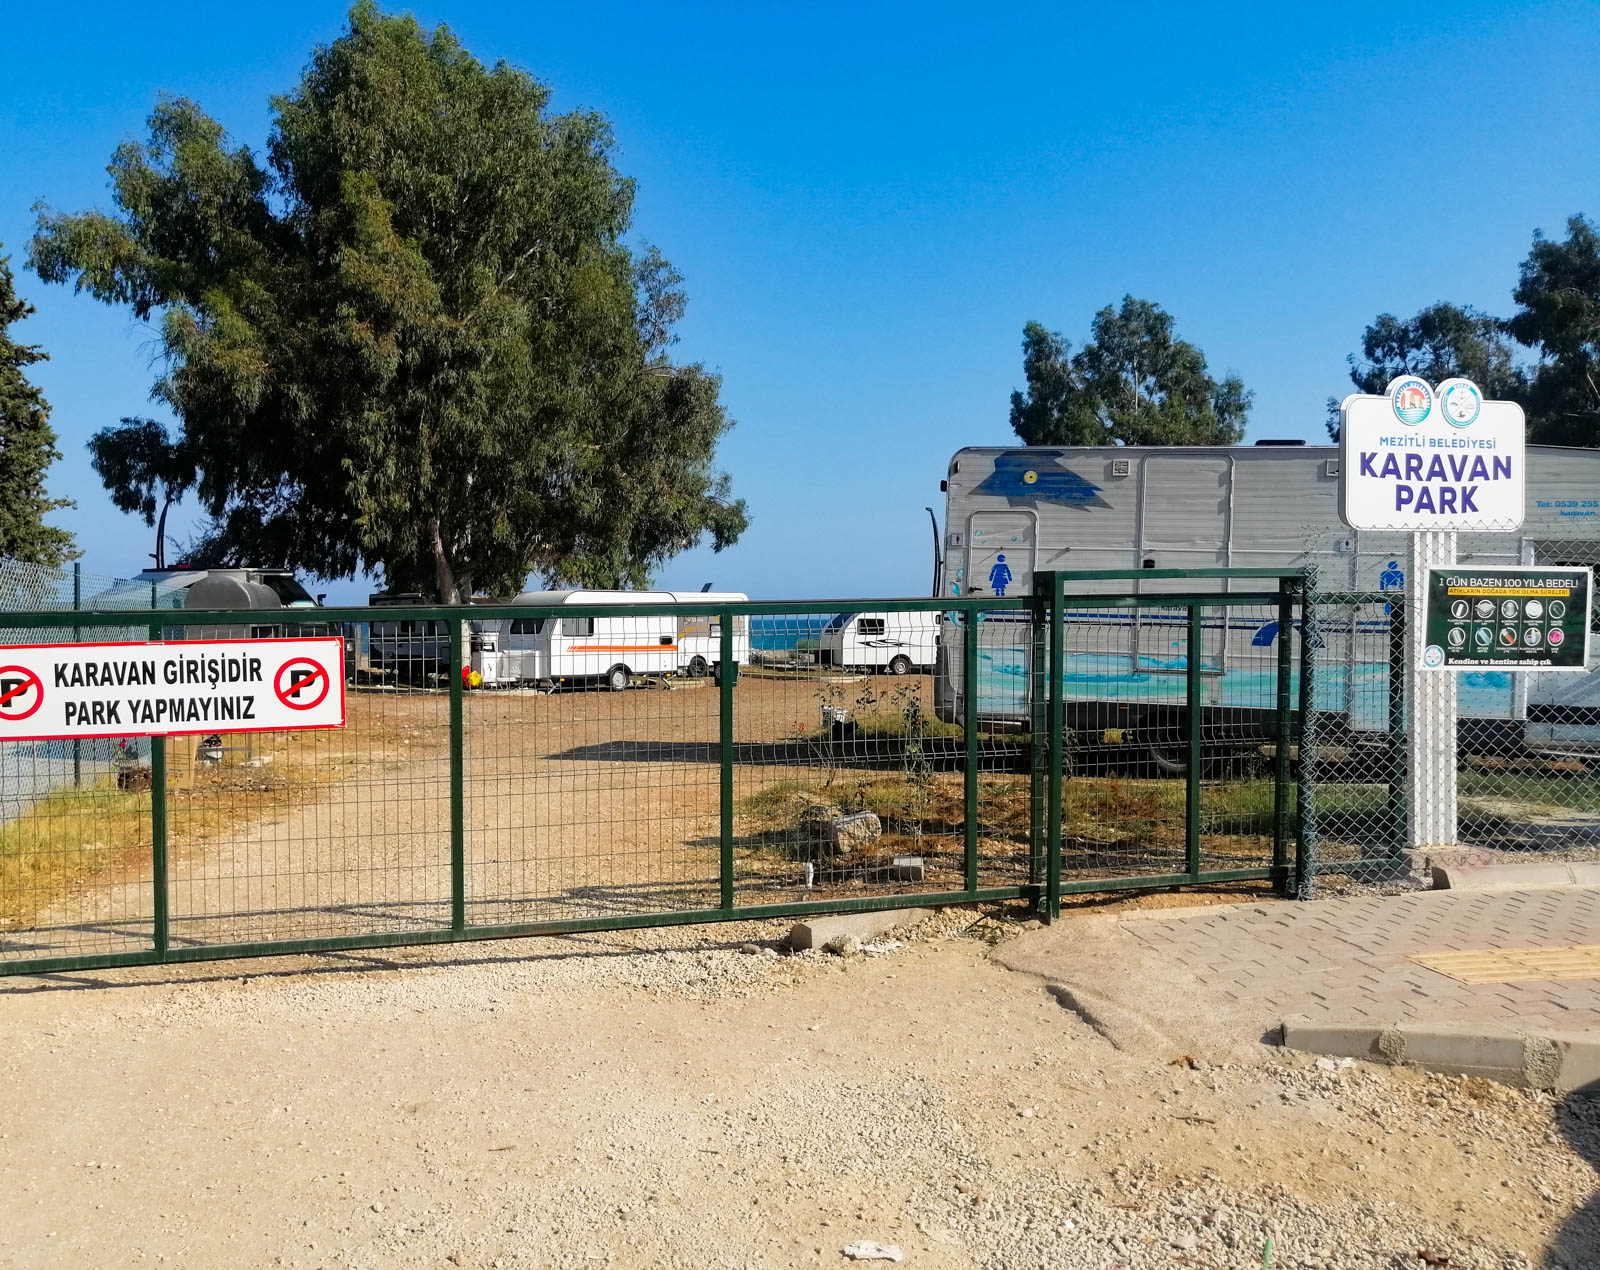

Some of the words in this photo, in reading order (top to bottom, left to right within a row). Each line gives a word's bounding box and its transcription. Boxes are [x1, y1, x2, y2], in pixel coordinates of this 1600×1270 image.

[1379, 434, 1426, 448] MEZİTLİ
[1429, 435, 1497, 449] BELEDİYESİ
[1360, 451, 1512, 482] KARAVAN
[1395, 484, 1479, 515] PARK
[1439, 577, 1444, 587] 1
[1446, 575, 1468, 587] GÜN
[1469, 577, 1502, 588] BAZEN
[1503, 578, 1522, 588] 100
[1523, 578, 1545, 588] YILA
[1546, 579, 1579, 589] BEDEL!
[54, 660, 156, 688] KARAVAN
[163, 652, 263, 689] GİRİŞİDİR
[64, 698, 122, 726] PARK
[128, 695, 256, 724] YAPMAYINIZ
